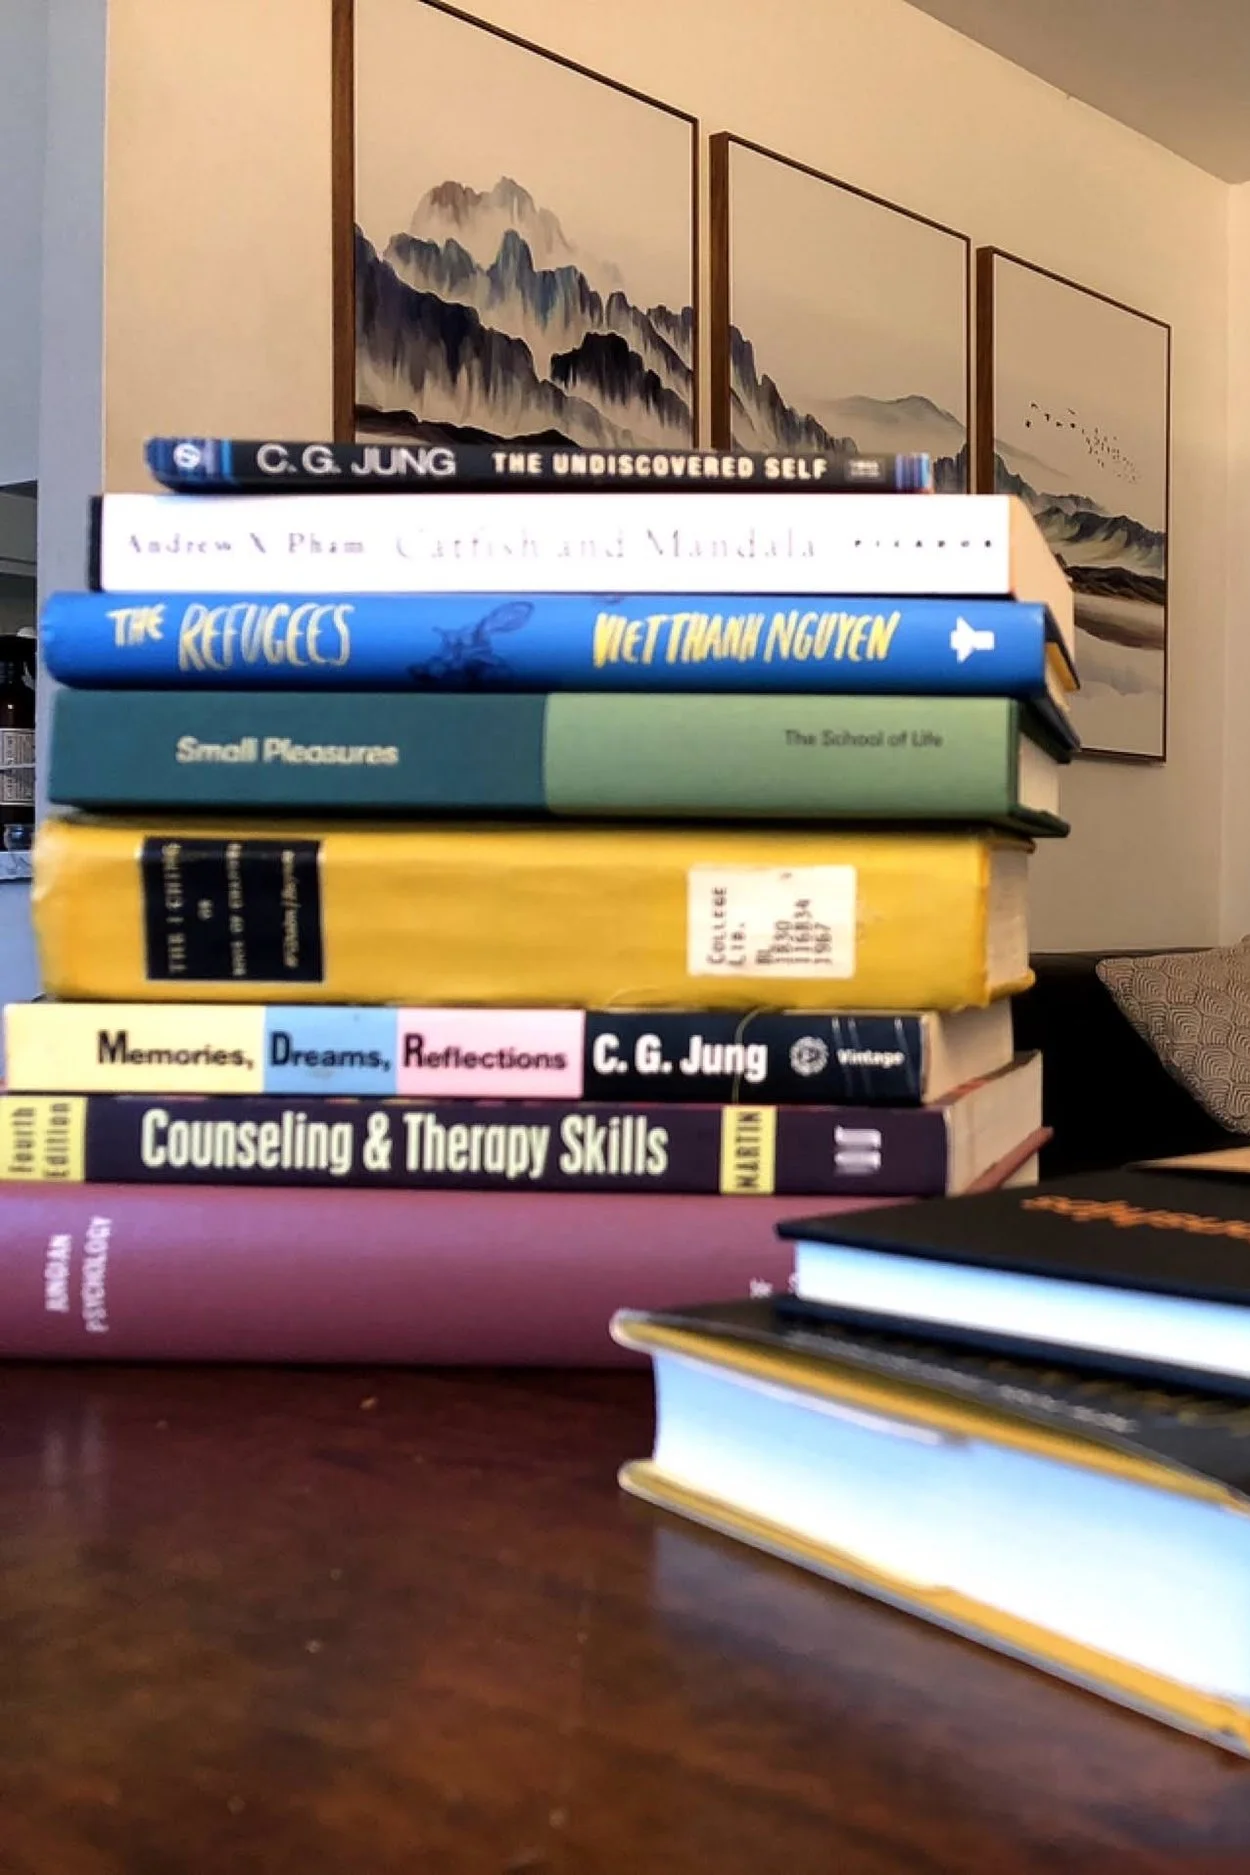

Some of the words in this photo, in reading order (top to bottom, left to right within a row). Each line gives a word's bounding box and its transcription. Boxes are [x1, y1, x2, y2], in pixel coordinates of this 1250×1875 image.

[257, 443, 297, 475] C.
[302, 444, 341, 475] G.
[351, 446, 456, 476] JUNG
[492, 452, 543, 475] THE
[552, 453, 754, 479] UNDISCOVERED
[764, 456, 828, 480] SELF
[130, 532, 231, 554] Andrew
[288, 532, 364, 554] Pham
[557, 528, 624, 559] and
[647, 528, 815, 559] Mandala
[107, 605, 166, 646] THE
[178, 602, 355, 672] REFUGEES
[593, 612, 668, 668] VIET
[667, 612, 765, 665] THANH
[764, 610, 901, 664] NGUYEN
[176, 737, 257, 765] Small
[265, 737, 399, 767] Pleasures
[785, 729, 817, 748] The
[822, 730, 885, 748] School
[889, 730, 907, 748] of
[911, 730, 943, 748] Life
[706, 886, 727, 965] COLLEGE
[98, 1030, 254, 1070] Memories,
[271, 1032, 391, 1073] Dreams,
[404, 1033, 567, 1071] Reflections
[593, 1034, 627, 1074] C.
[636, 1035, 672, 1075] G.
[680, 1036, 768, 1082] Jung
[837, 1048, 905, 1068] Vintage
[8, 1107, 36, 1174] Fourth
[43, 1103, 71, 1178] Edition
[141, 1108, 353, 1177] Counseling
[363, 1113, 392, 1171] &
[404, 1114, 550, 1179] Therapy
[560, 1115, 669, 1177] Skills
[734, 1111, 761, 1189] MARTIN
